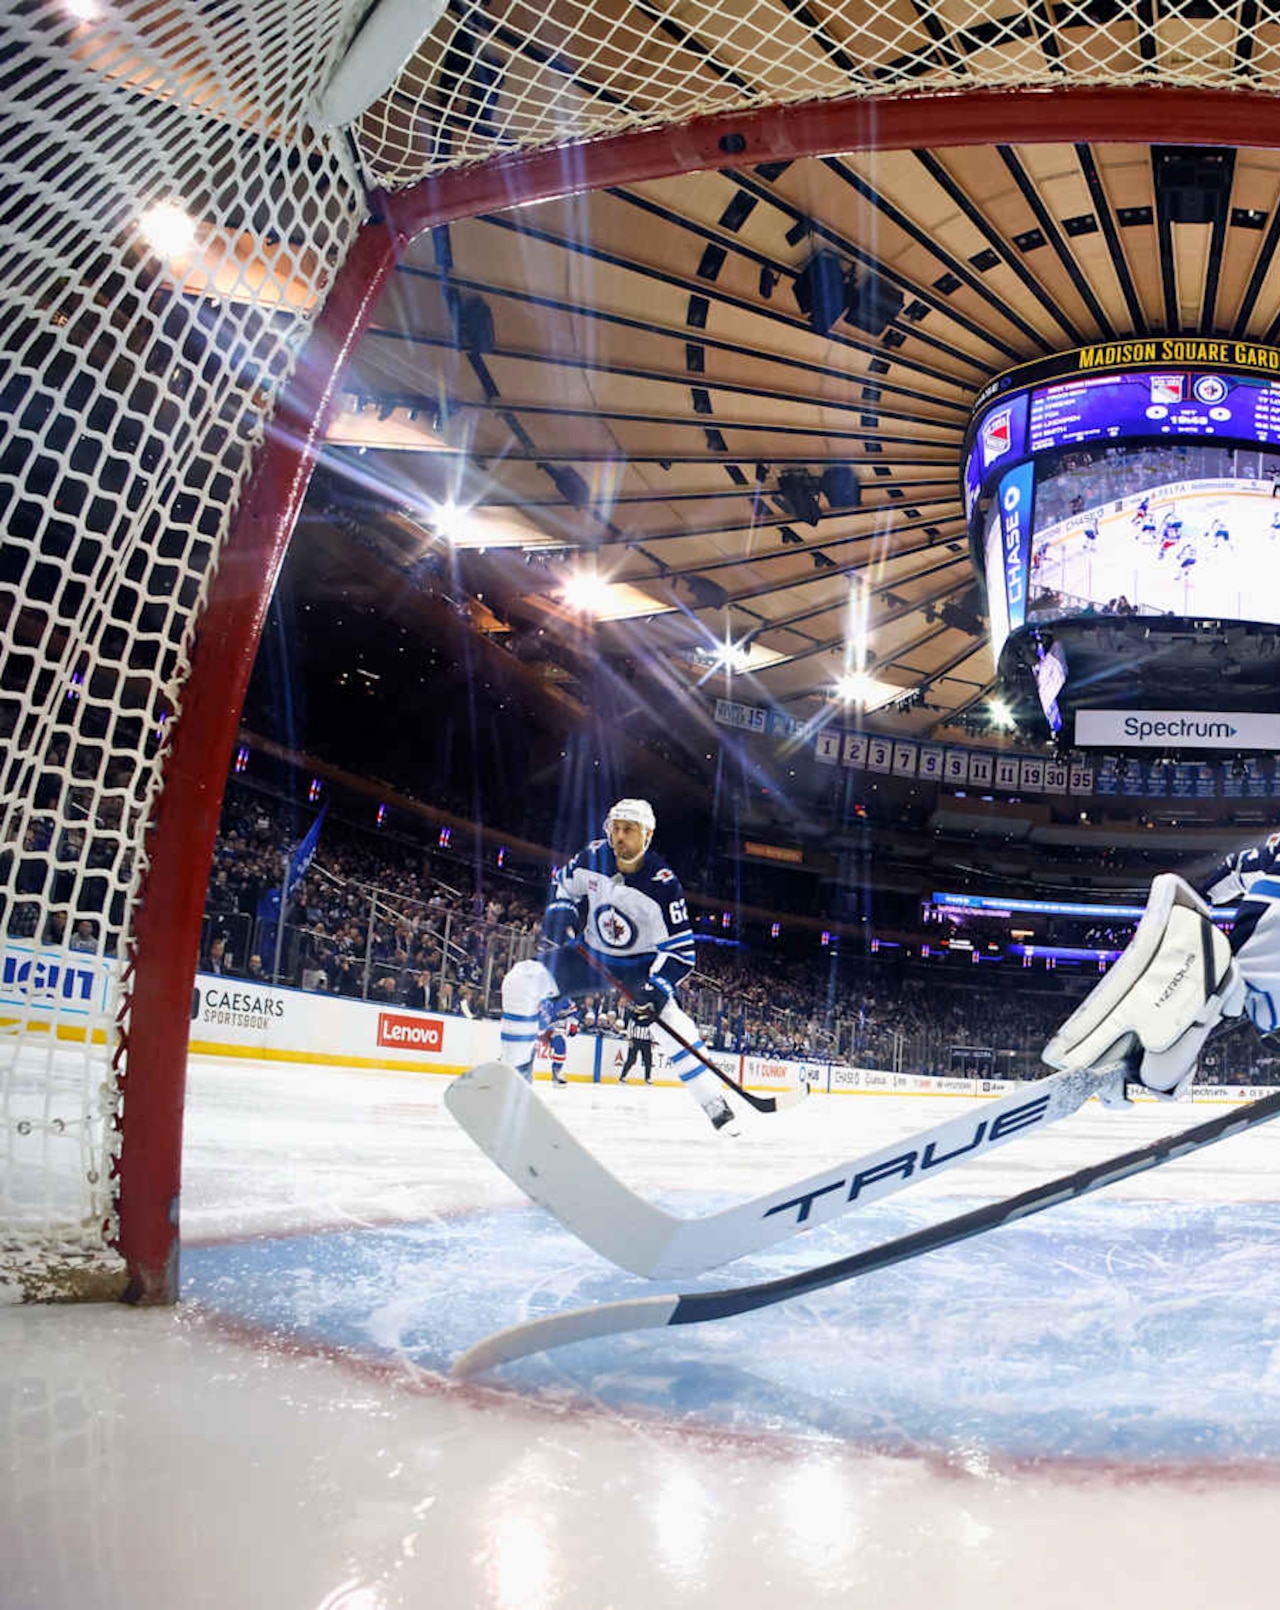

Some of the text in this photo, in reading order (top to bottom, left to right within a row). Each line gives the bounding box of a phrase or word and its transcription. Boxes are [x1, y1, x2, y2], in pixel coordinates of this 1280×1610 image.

[1079, 343, 1156, 370] MADISON
[1161, 339, 1230, 362] SQUARE
[1005, 511, 1022, 604] CHASE
[1124, 717, 1230, 740] Spectrum
[850, 744, 860, 759] 2
[875, 749, 885, 764] 3
[900, 753, 909, 768] 7
[926, 757, 937, 772] 9
[951, 760, 961, 775] 9
[973, 763, 987, 779] 11
[1000, 767, 1014, 783] 11
[1023, 769, 1040, 784] 19
[1046, 771, 1065, 786] 30
[1072, 772, 1091, 788] 35
[205, 989, 284, 1017] CAESARS
[203, 1009, 269, 1030] SPORTSBOOK
[383, 1020, 439, 1044] Lenovo
[762, 1093, 1051, 1223] TRUE
